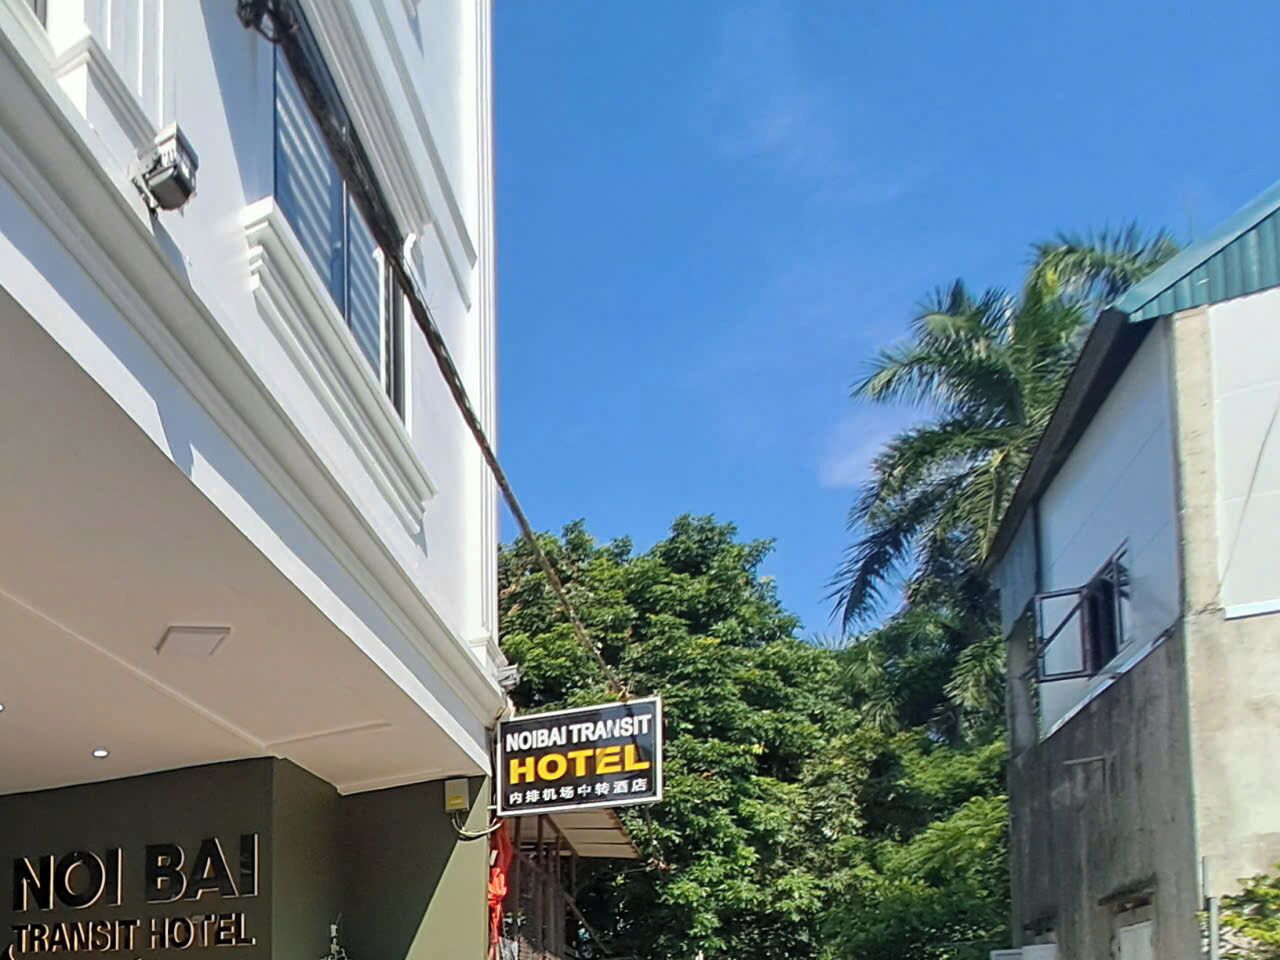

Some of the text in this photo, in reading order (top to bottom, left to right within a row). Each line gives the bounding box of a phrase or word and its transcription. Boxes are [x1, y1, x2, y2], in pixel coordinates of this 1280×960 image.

[506, 714, 651, 752] NOIBAI TRANSIT
[509, 744, 650, 785] HOTEL
[509, 778, 648, 804] 内排机场中转酒店
[13, 832, 259, 911] NOI BAI
[11, 913, 255, 953] TRANSIT HOTEL
